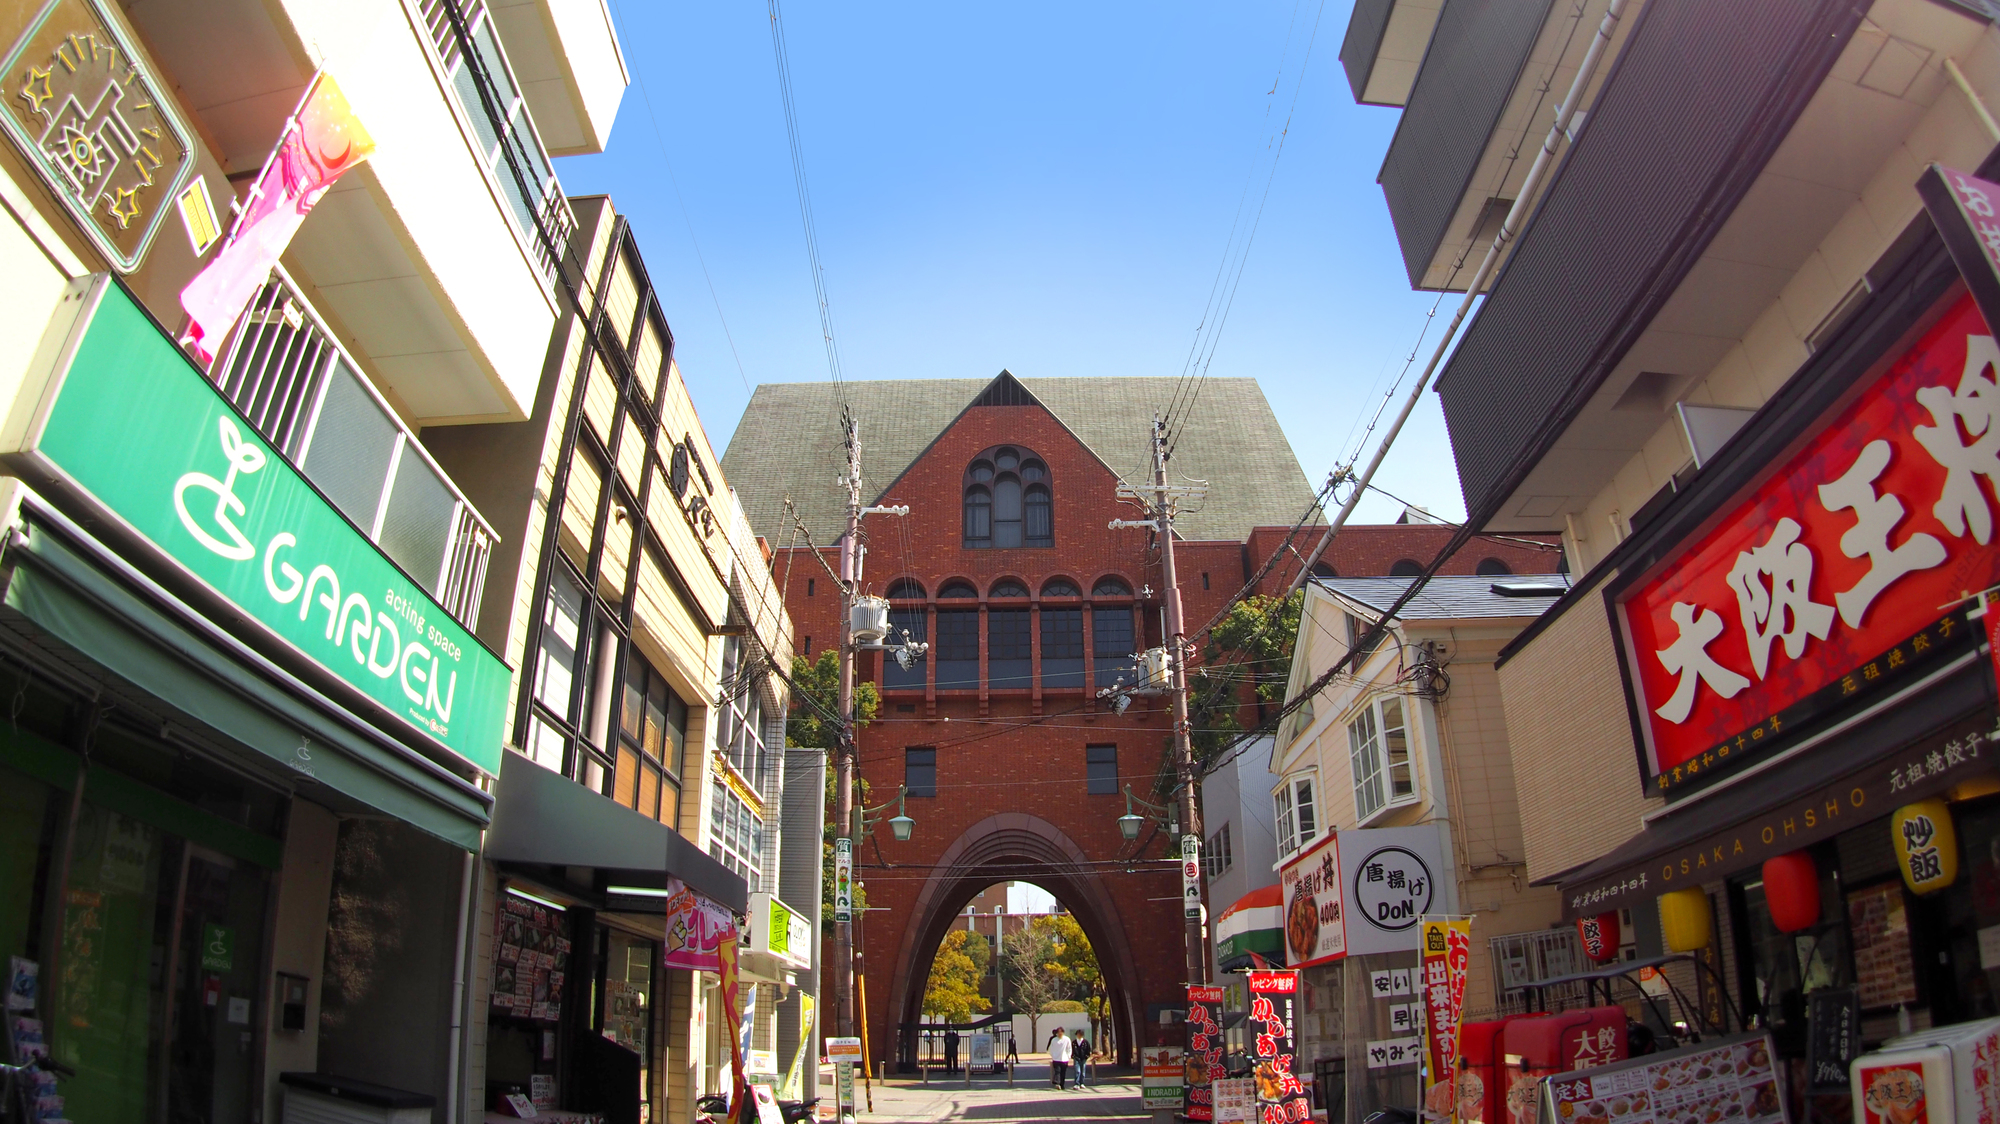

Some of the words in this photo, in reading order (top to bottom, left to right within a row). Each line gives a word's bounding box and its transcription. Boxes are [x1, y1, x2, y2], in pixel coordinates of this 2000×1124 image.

[188, 205, 202, 236] OPEN
[263, 532, 457, 723] GARDEN
[385, 588, 426, 634] acting
[428, 625, 461, 662] space
[1841, 618, 1956, 695] 元祖焼餃子
[1657, 715, 1784, 789] 創業昭和四十四年
[1662, 839, 1744, 881] OSAKA
[1761, 787, 1866, 844] OHSHO
[837, 840, 851, 852] 質
[1183, 841, 1196, 854] 質
[1902, 815, 1941, 883] 炒飯
[1295, 851, 1335, 903] 唐揚げ丼
[1366, 862, 1425, 896] 唐揚げ
[1572, 873, 1648, 908] 創業昭和四十四年
[1320, 901, 1341, 926] 400円
[1378, 899, 1414, 920] DoN
[1428, 934, 1443, 942] TAKE
[1581, 915, 1603, 956] 餃子
[202, 956, 232, 970] GARDEN
[1252, 977, 1294, 990] トッピング無料
[1189, 990, 1221, 1000] トッピング無料
[1370, 1043, 1420, 1063] やみつ
[1147, 1087, 1181, 1096] INDRADIP
[1190, 1088, 1213, 1104] 400
[1507, 1087, 1537, 1104] 大阪王
[1556, 1080, 1591, 1102] 定食
[1866, 1080, 1924, 1101] 大阪王将
[1189, 1107, 1213, 1117] ボリュー
[1263, 1101, 1309, 1124] 400円
